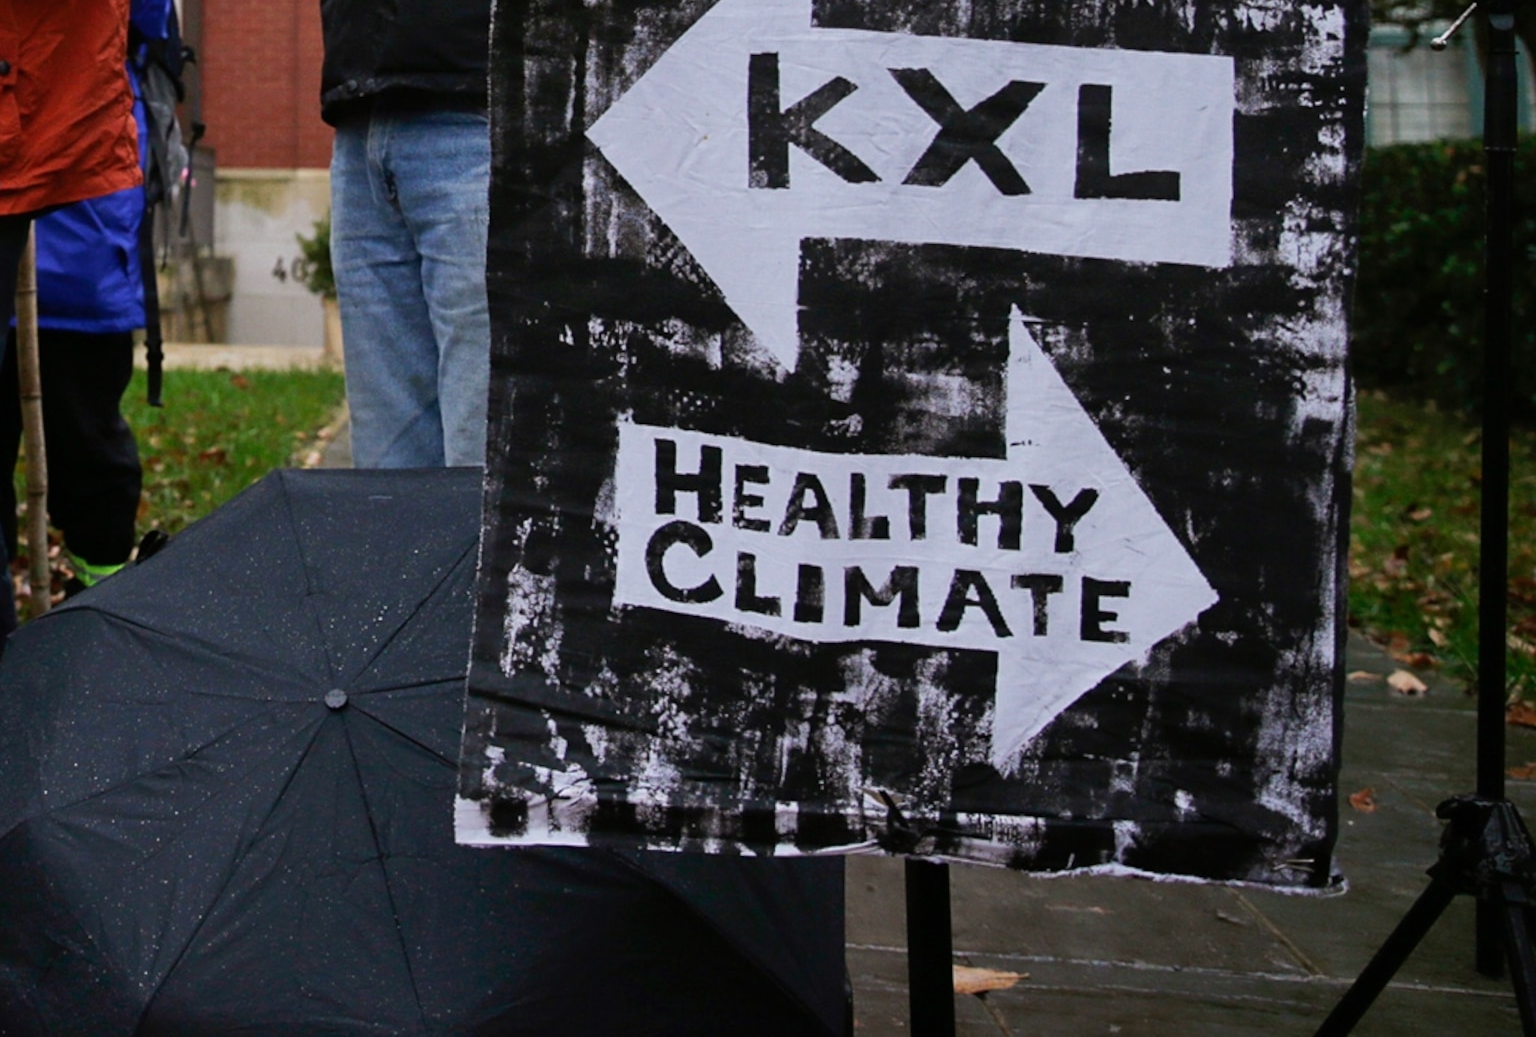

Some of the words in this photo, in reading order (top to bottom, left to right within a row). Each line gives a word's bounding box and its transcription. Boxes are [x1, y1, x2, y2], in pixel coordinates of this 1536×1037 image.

[746, 53, 1181, 200] KXL
[654, 437, 1099, 554] HEALTHY
[644, 520, 1132, 644] CLIMATE
